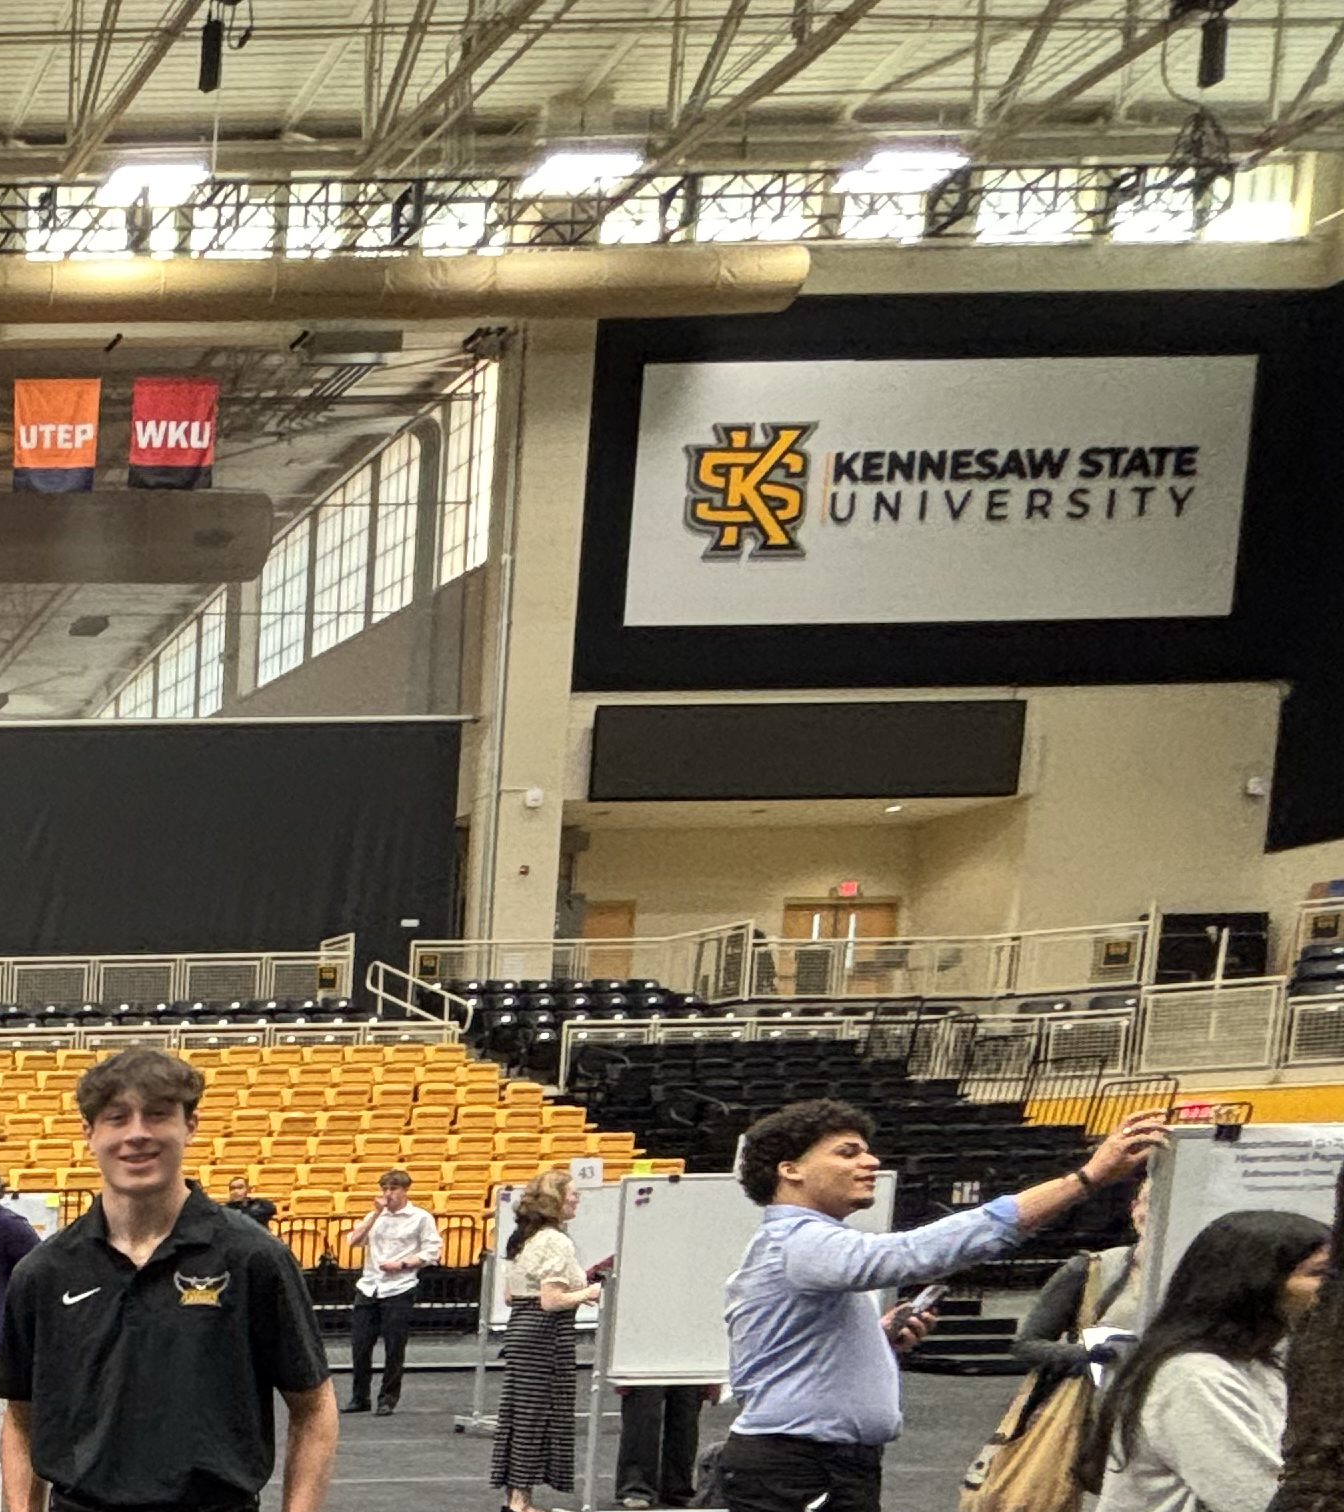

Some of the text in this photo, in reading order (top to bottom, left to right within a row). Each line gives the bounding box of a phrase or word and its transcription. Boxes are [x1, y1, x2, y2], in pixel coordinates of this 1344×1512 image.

[19, 423, 95, 450] UTEP
[134, 419, 212, 450] WKU
[832, 445, 1200, 484] KENNESAW STATE
[828, 485, 1196, 524] UNIVERSITY
